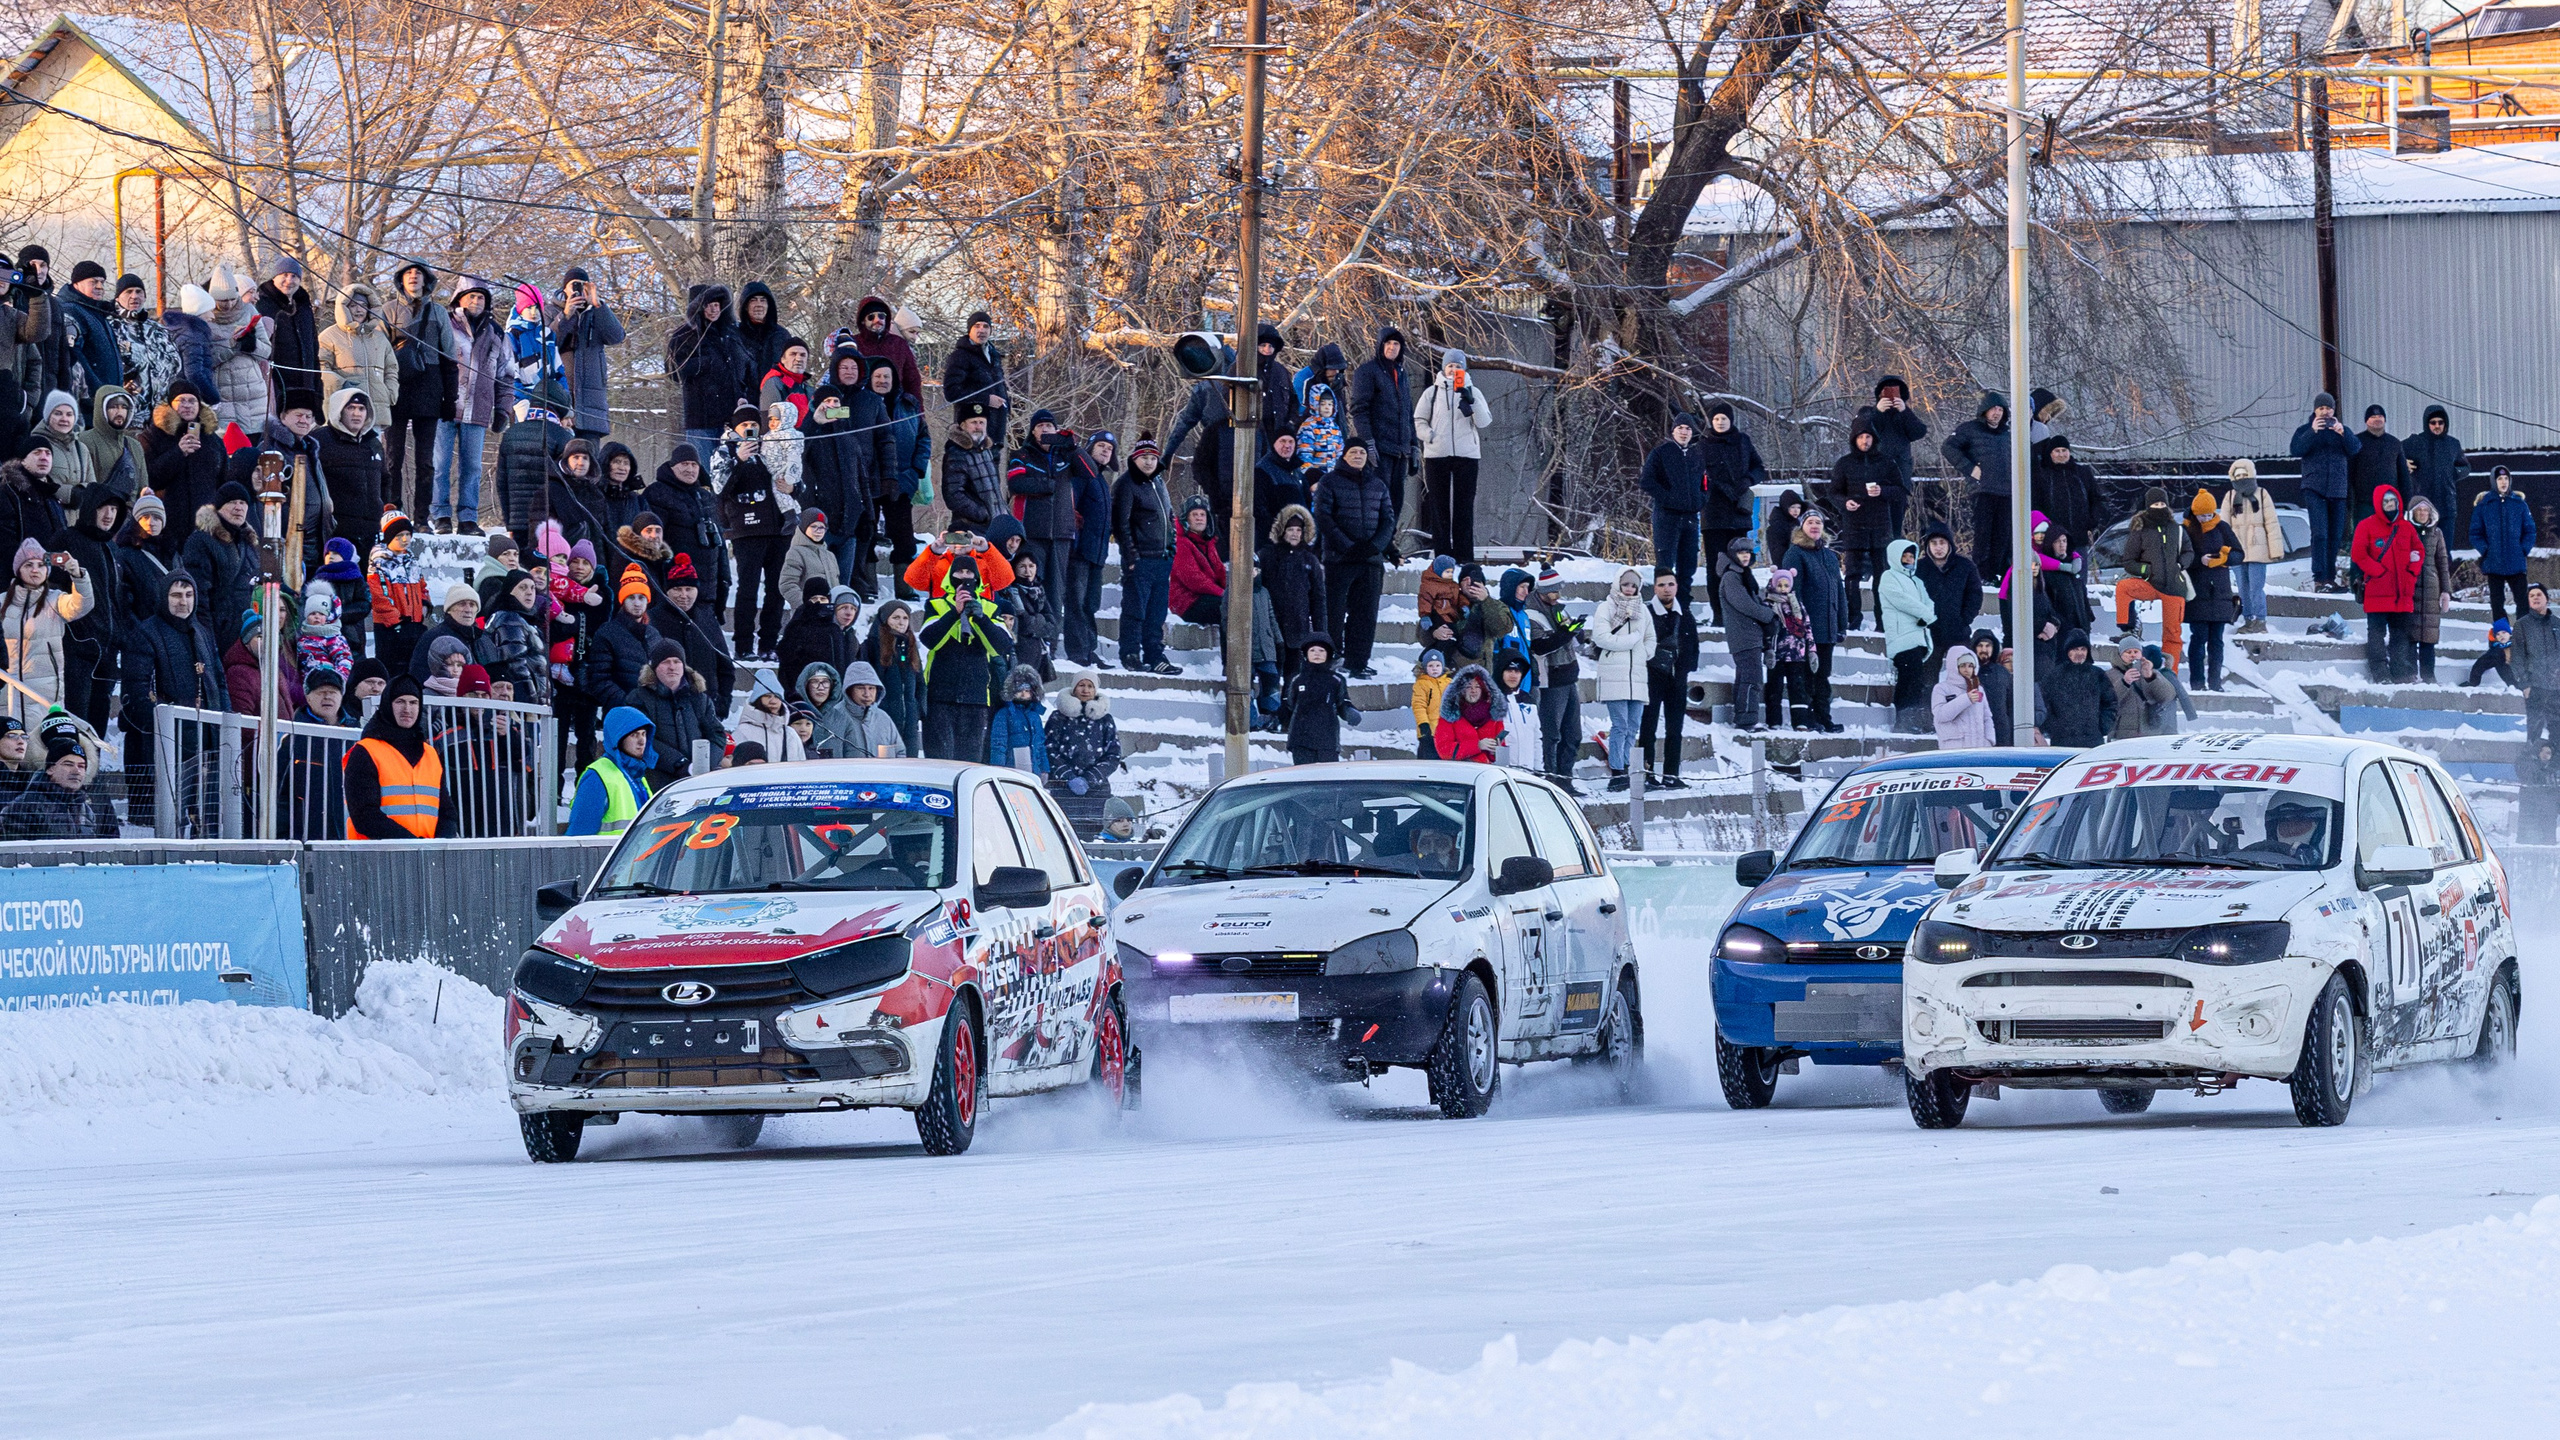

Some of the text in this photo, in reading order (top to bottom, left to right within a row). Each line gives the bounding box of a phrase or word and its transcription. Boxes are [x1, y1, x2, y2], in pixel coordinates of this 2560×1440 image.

[2075, 762, 2300, 788] Вулкан
[739, 790, 793, 799] ЧЕМПИОНАТ
[1822, 800, 1867, 824] 23
[634, 812, 740, 862] 78
[0, 899, 83, 932] СТЕРСТВО
[1220, 920, 1271, 928] eurol
[0, 940, 232, 978] ЧЕСКОЙ КУЛЬТУРЫ И СПОРТА
